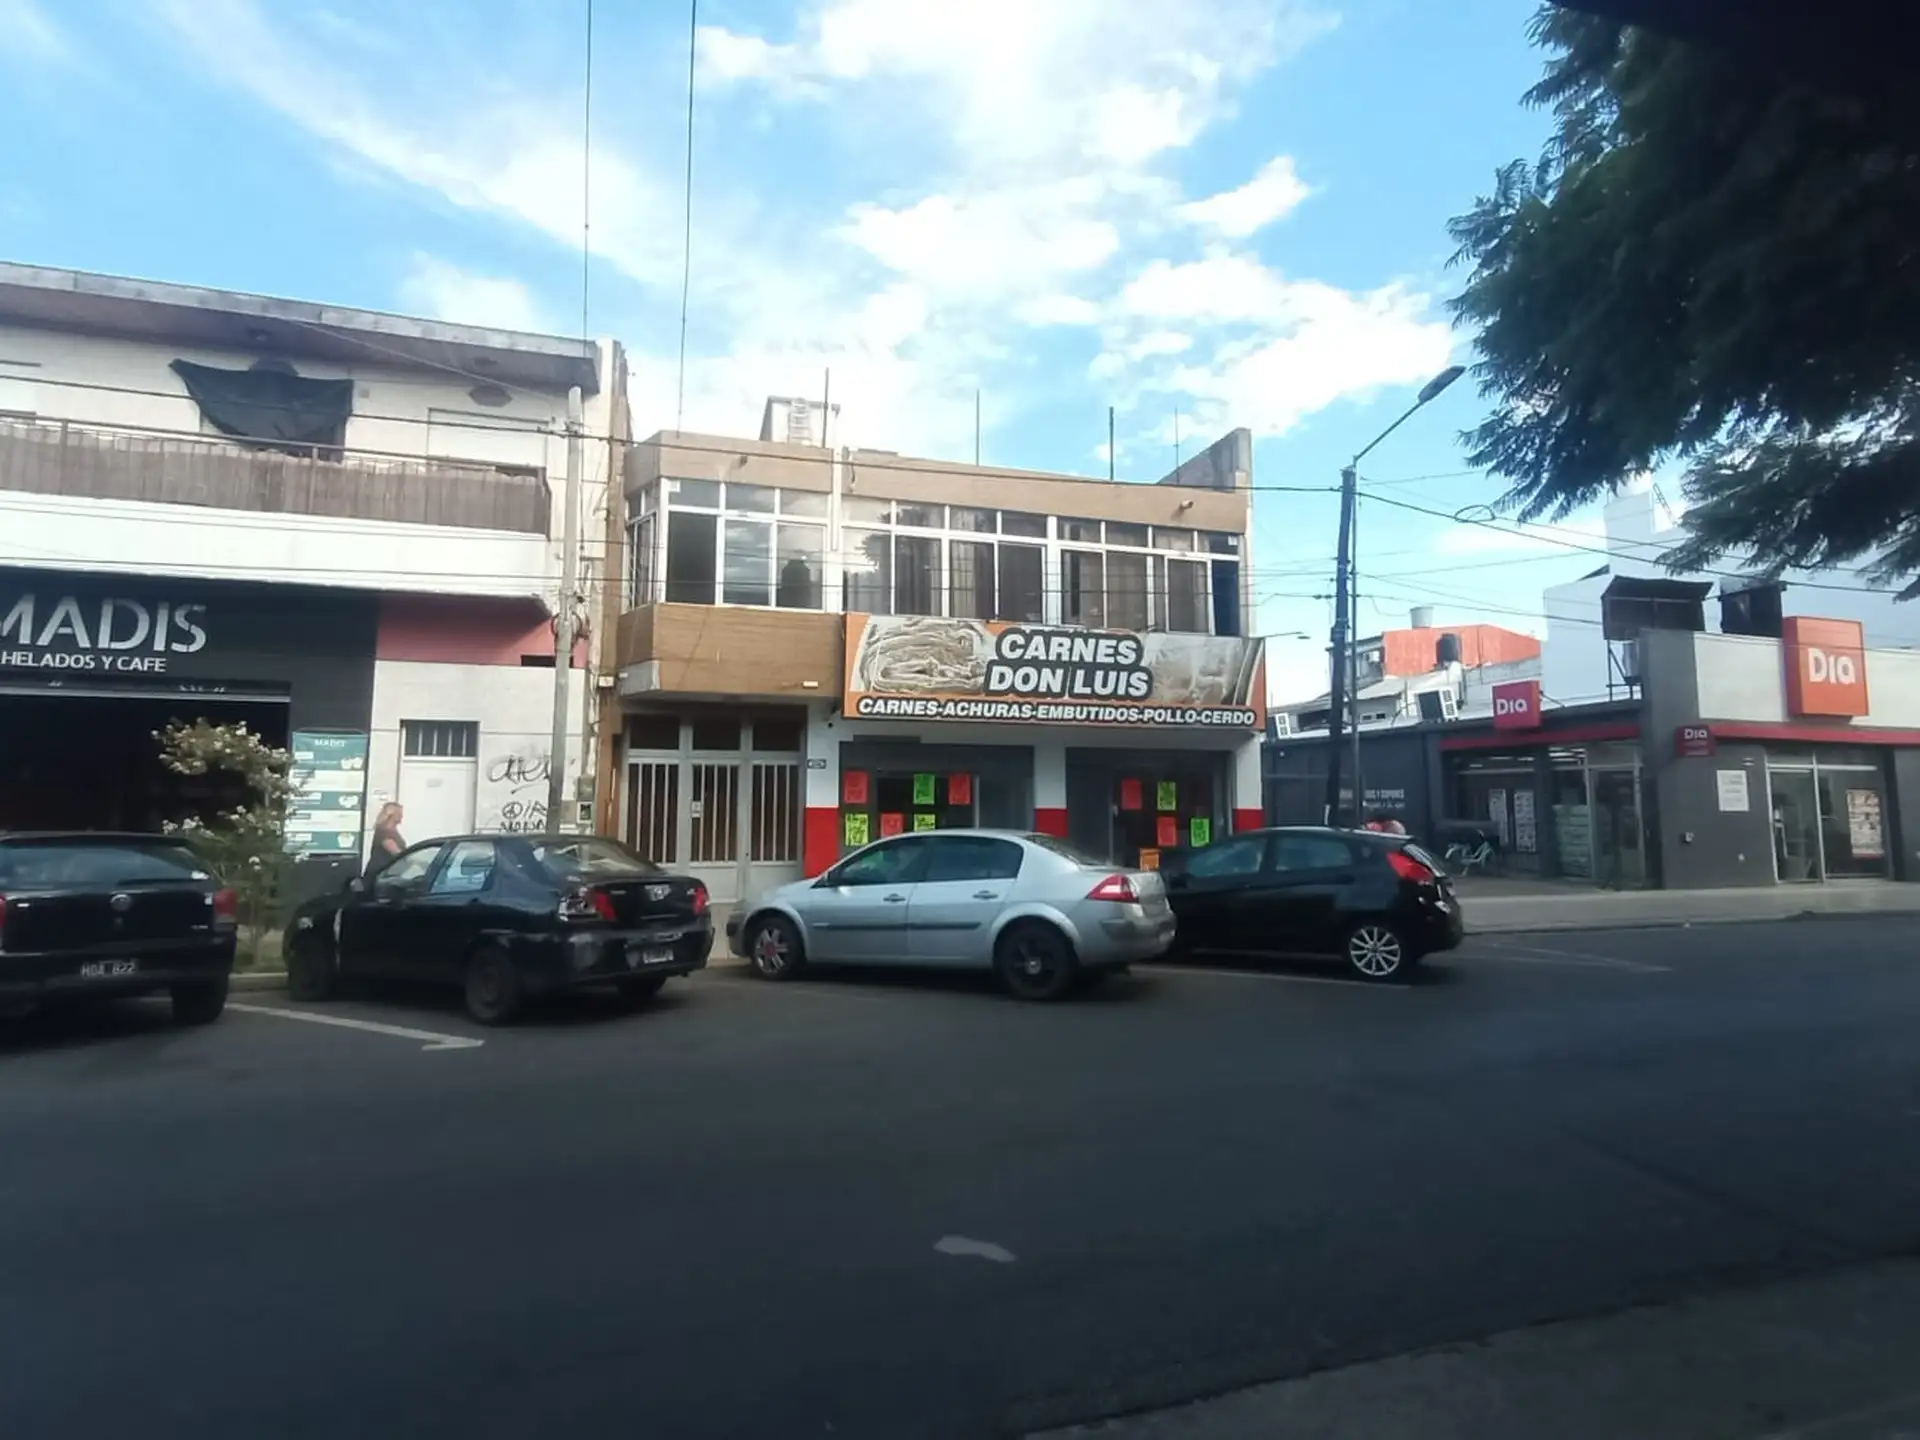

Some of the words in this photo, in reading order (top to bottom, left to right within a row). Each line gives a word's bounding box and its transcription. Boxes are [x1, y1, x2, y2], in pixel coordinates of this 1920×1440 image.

[0, 593, 207, 652] MADIS
[1, 651, 96, 670] HELADOS
[101, 656, 113, 671] Y
[117, 657, 167, 673] CAFE
[1000, 634, 1138, 665] CARNES
[989, 666, 1062, 694] DON
[1073, 669, 1149, 697] LUIS
